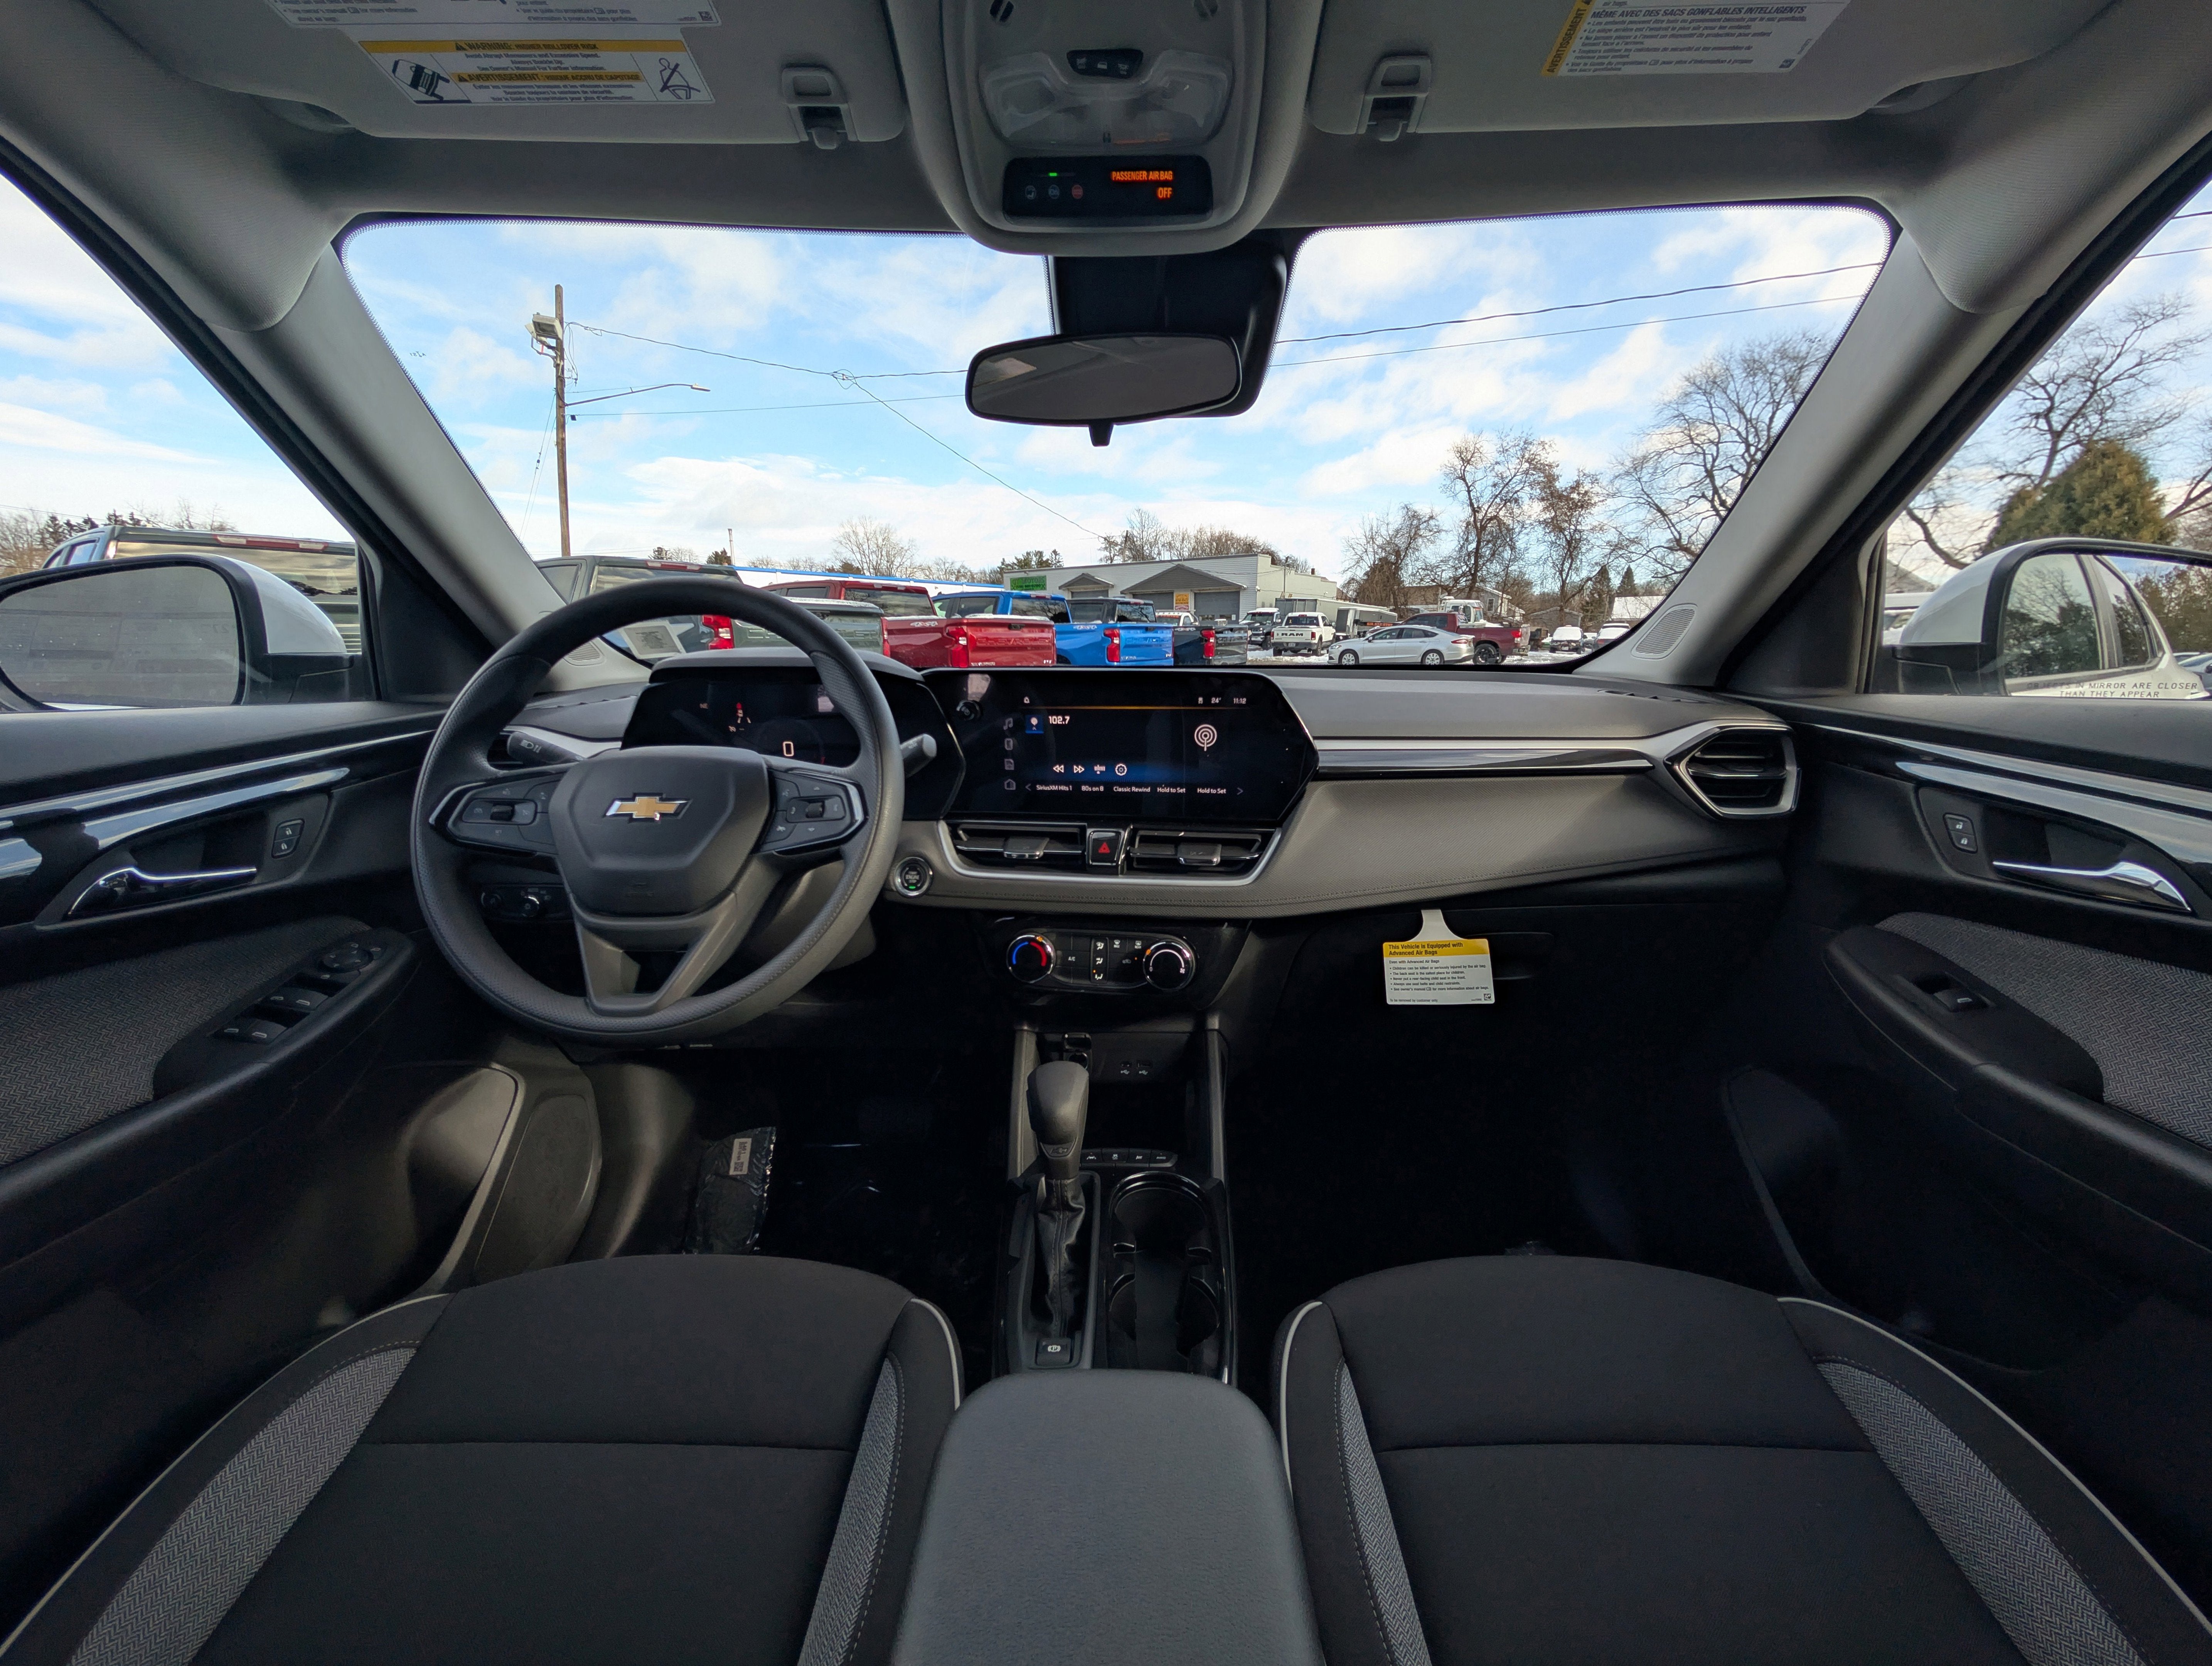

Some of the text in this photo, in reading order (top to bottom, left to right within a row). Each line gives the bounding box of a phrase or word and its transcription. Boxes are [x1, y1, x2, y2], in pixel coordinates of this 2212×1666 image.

[1618, 9, 1643, 18] AVEC
[1643, 9, 1660, 17] DES
[1686, 7, 1743, 16] GONFLABLES
[1743, 5, 1807, 15] INTELLIGENTS
[1547, 8, 1587, 73] AVERTISSEMENT
[1112, 171, 1173, 180] PASSENGER AIR BAG
[1158, 187, 1172, 198] OFF
[1048, 715, 1070, 724] 102.7
